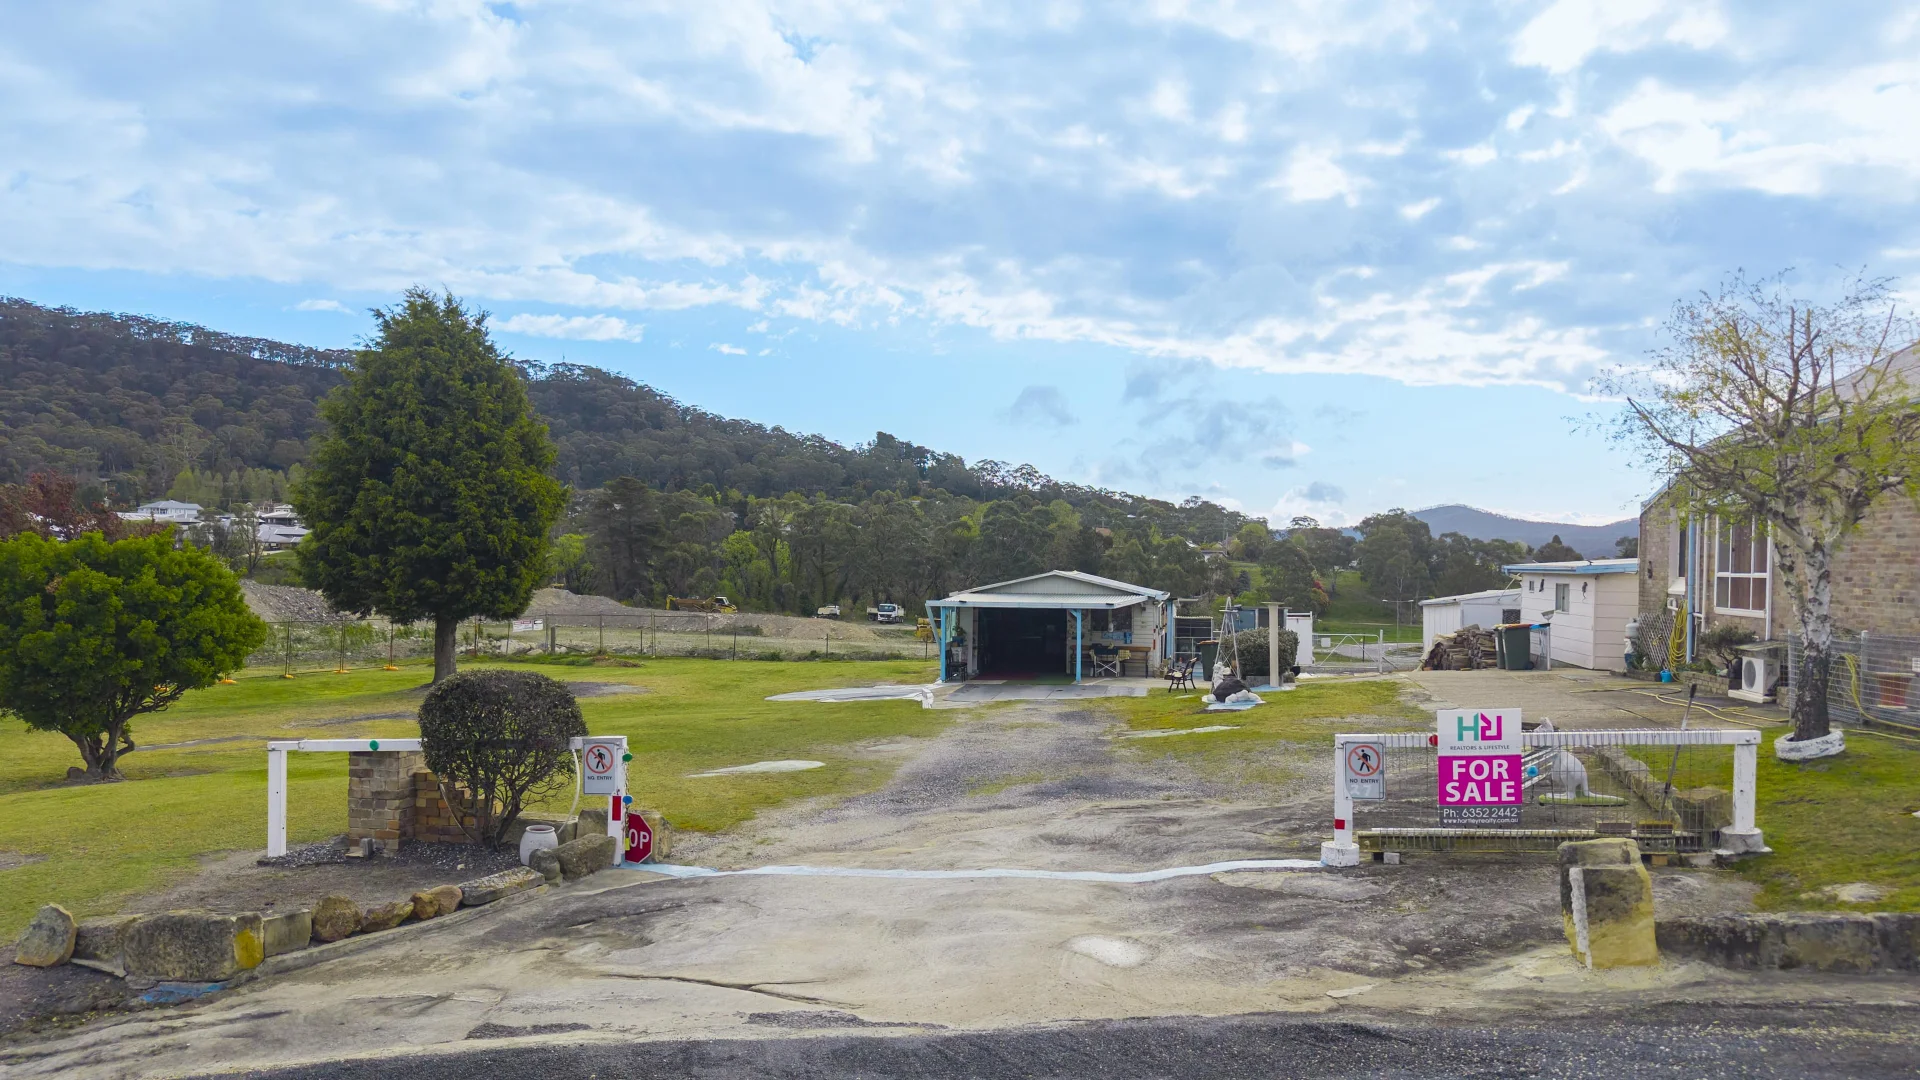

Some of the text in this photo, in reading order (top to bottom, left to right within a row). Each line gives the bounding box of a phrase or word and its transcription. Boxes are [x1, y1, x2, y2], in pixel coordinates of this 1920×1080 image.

[1452, 759, 1509, 780] FOR
[1445, 781, 1516, 802] SALE
[1443, 808, 1518, 818] Ph: 6352 2442
[629, 828, 650, 850] OP
